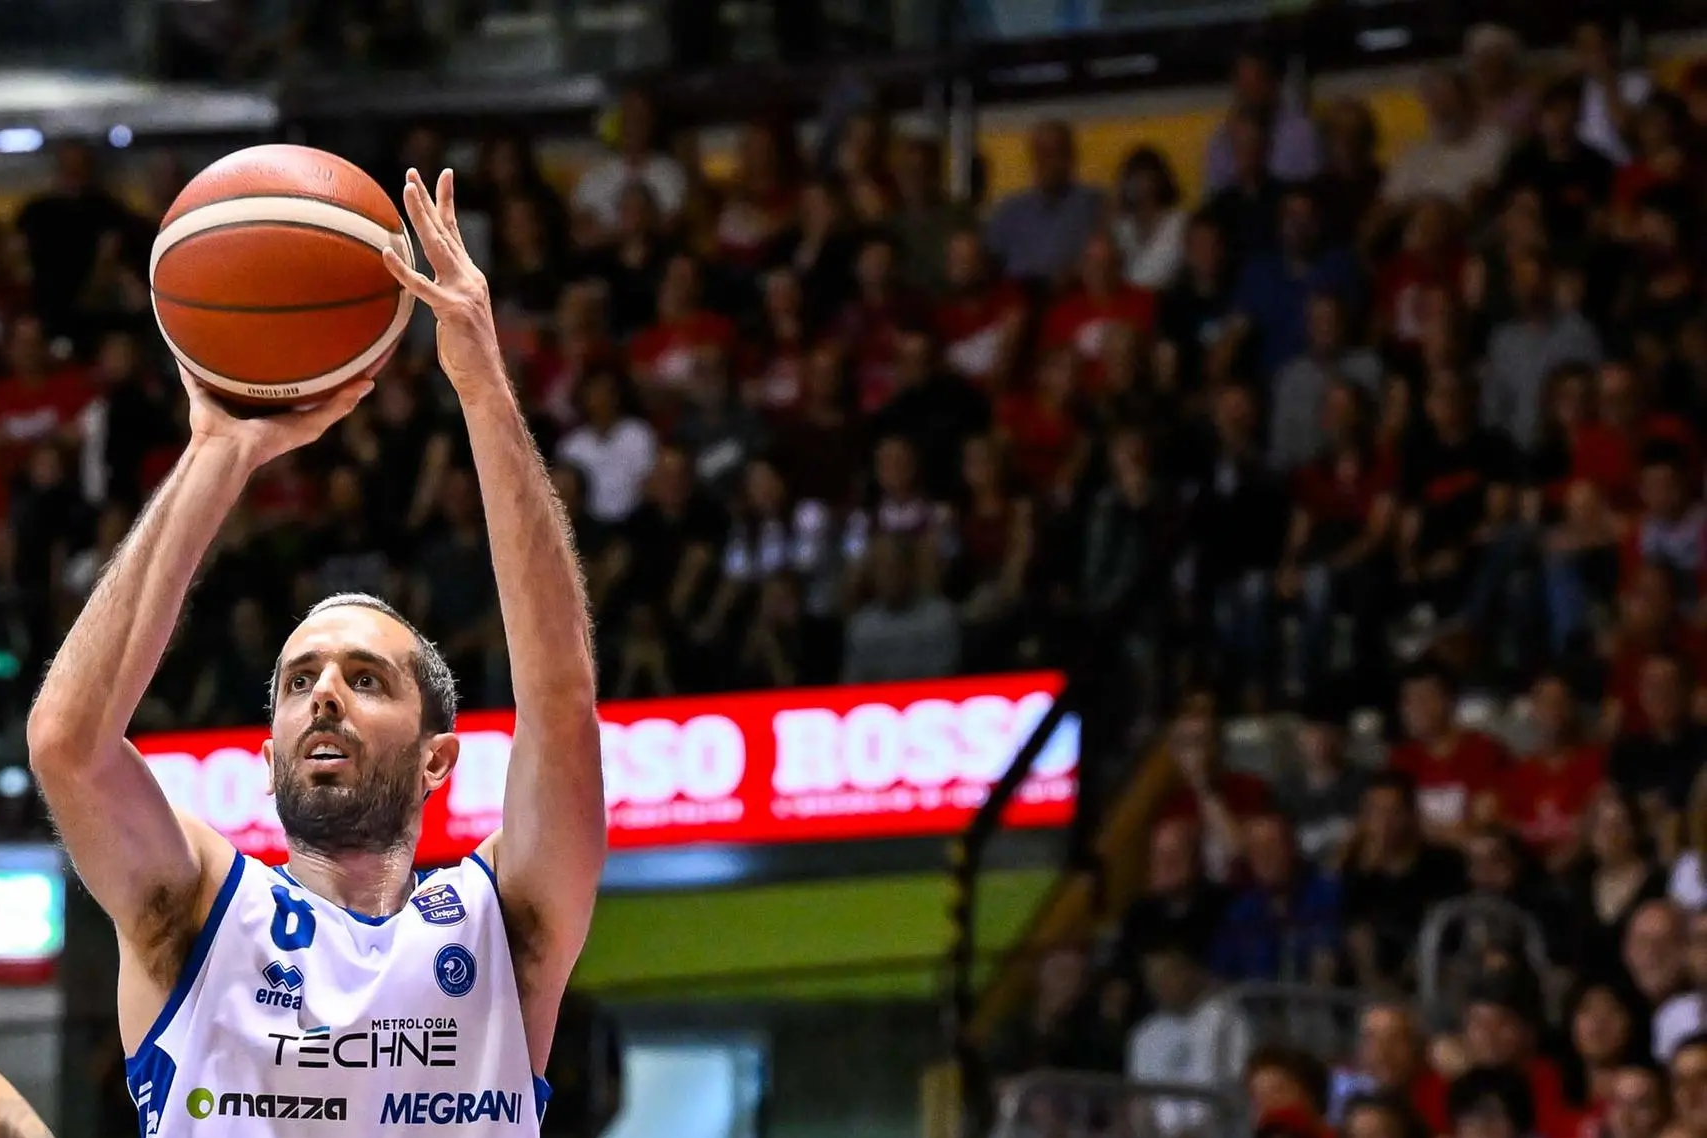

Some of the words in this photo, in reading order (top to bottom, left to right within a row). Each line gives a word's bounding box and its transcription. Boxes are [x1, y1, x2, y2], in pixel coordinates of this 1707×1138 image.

[418, 891, 454, 906] LBA
[430, 906, 460, 919] Unipol
[371, 1017, 458, 1031] METROLOGIA
[218, 1092, 348, 1121] mazza
